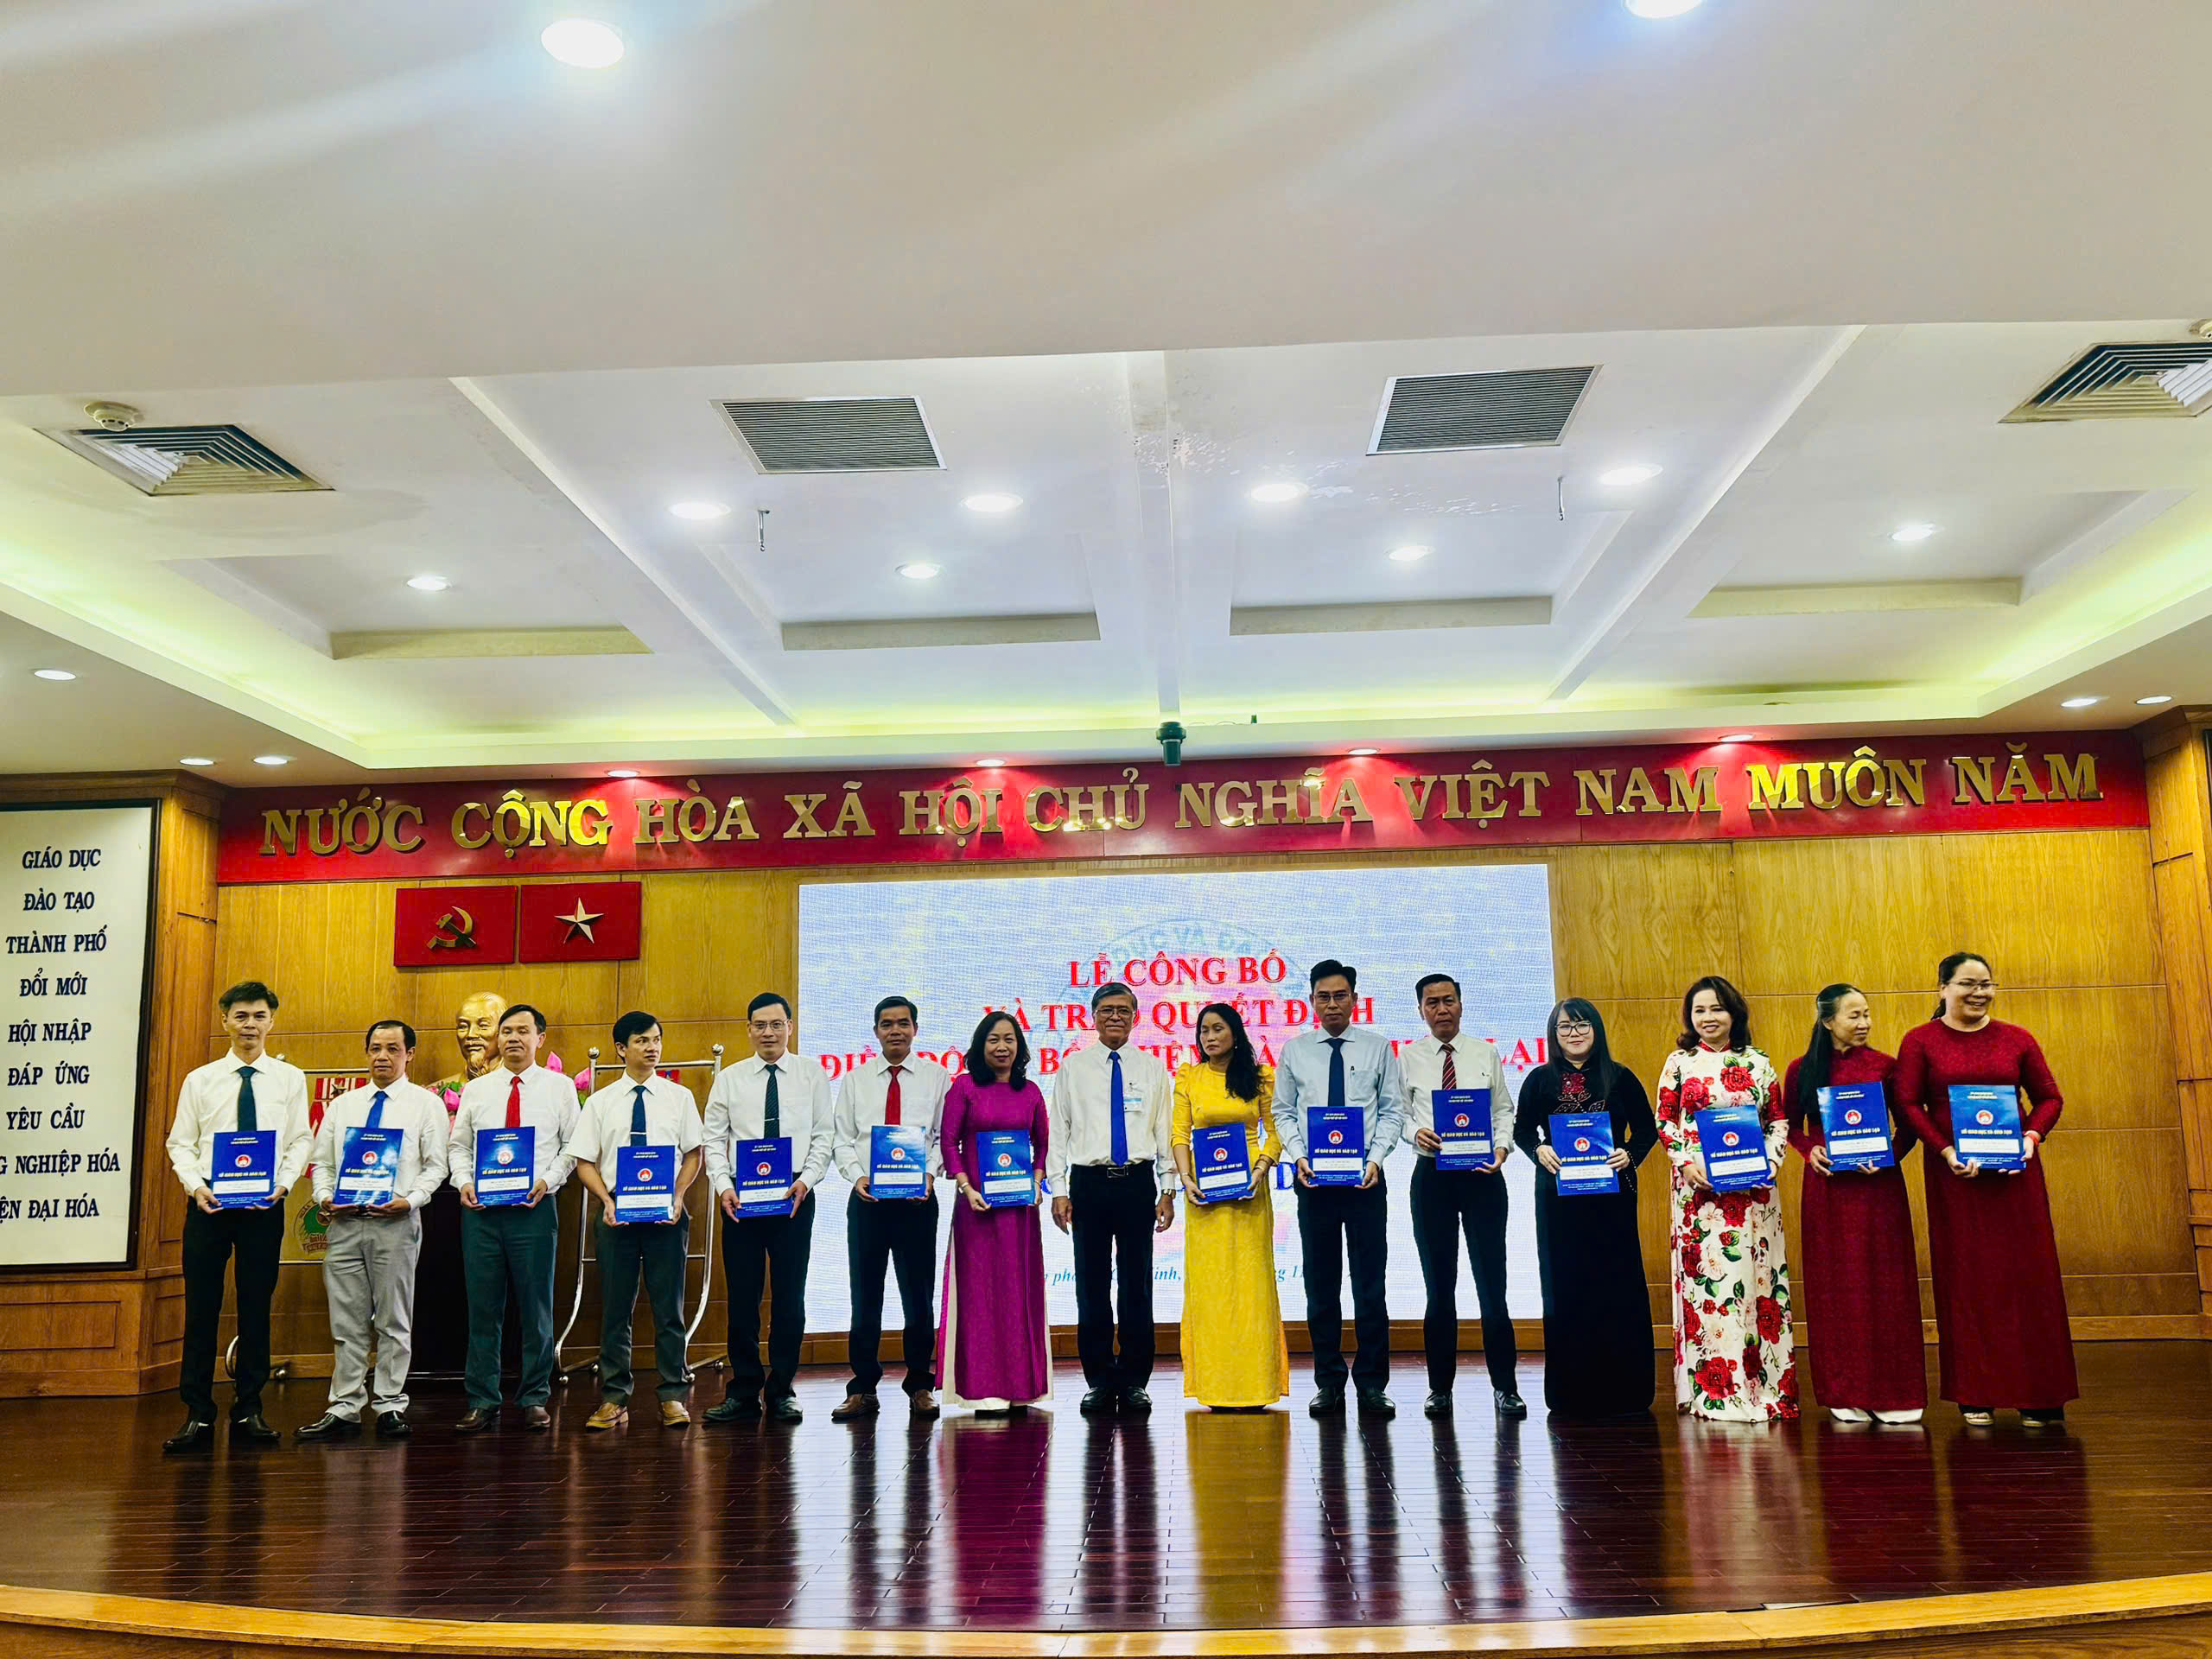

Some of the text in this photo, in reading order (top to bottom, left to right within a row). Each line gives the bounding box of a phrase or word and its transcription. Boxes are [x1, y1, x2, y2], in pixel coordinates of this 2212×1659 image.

[260, 742, 2104, 858] NƯỚC CỘNG HÒA XÃ HỘI CHỦ NGHĨA VIỆT NAM MUÔN NĂM
[22, 846, 101, 871] GIÁO DỤC
[22, 887, 95, 913] ĐÀO TẠO
[5, 924, 107, 954] THÀNH PHỐ
[19, 967, 88, 996] ĐỔI MỚI
[1070, 949, 1287, 988] LỄ CÔNG BỐ
[1152, 993, 1274, 1034] QUẾT
[1284, 997, 1375, 1030] ĐH
[8, 1018, 92, 1046] HỘI NHẬP
[8, 1060, 90, 1086] ĐÁP ỨNG
[6, 1103, 85, 1129] YÊU CẦU
[15, 1149, 81, 1176] NGHIỆP
[87, 1147, 120, 1173] HÓA
[28, 1199, 59, 1222] ĐẠI
[65, 1192, 99, 1217] HÓA
[1153, 1266, 1182, 1281] inh,
